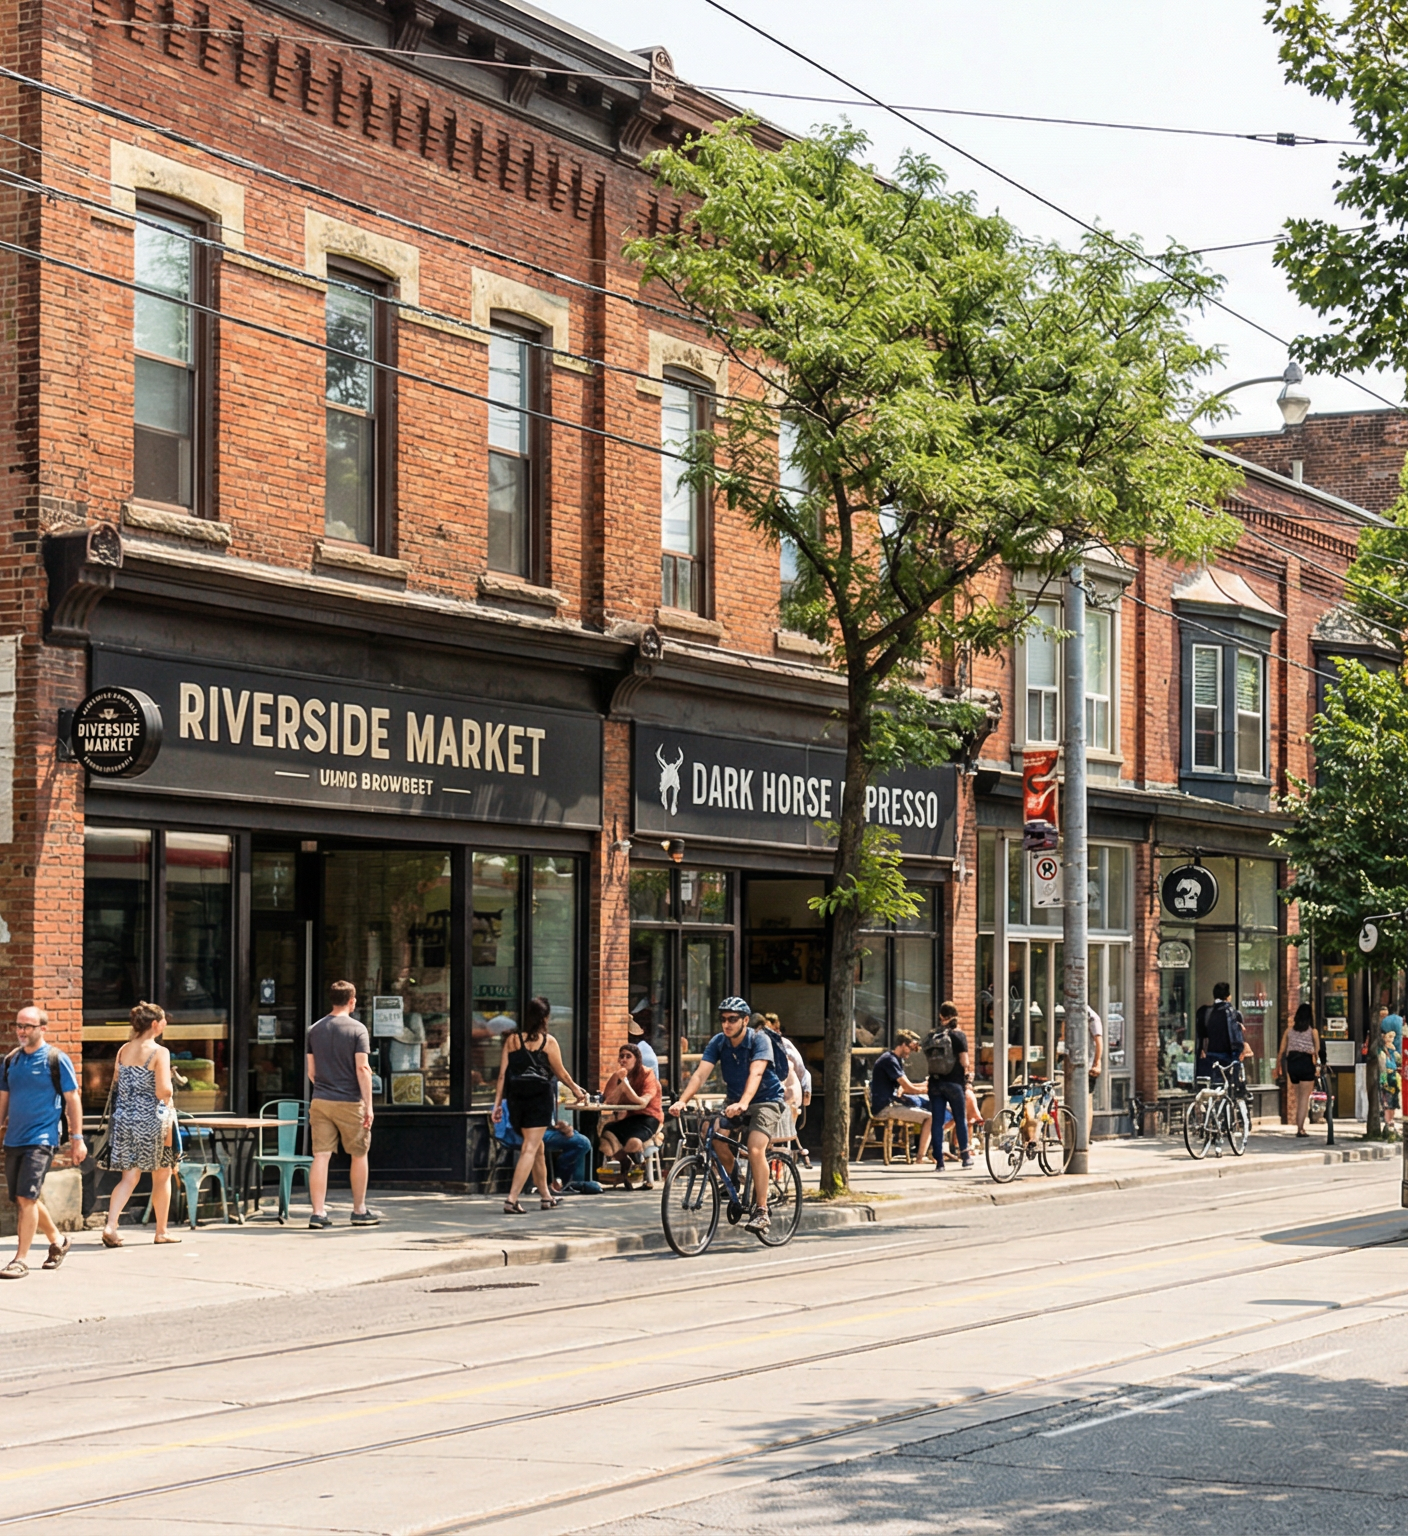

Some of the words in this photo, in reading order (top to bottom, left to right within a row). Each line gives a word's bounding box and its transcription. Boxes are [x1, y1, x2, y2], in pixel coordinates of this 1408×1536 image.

[84, 738, 134, 752] MARKET
[179, 682, 390, 760] RIVERSIDE
[406, 711, 546, 776] MARKET
[692, 762, 754, 810] DARK
[762, 771, 832, 819] HORSE
[841, 781, 938, 829] PRESSO
